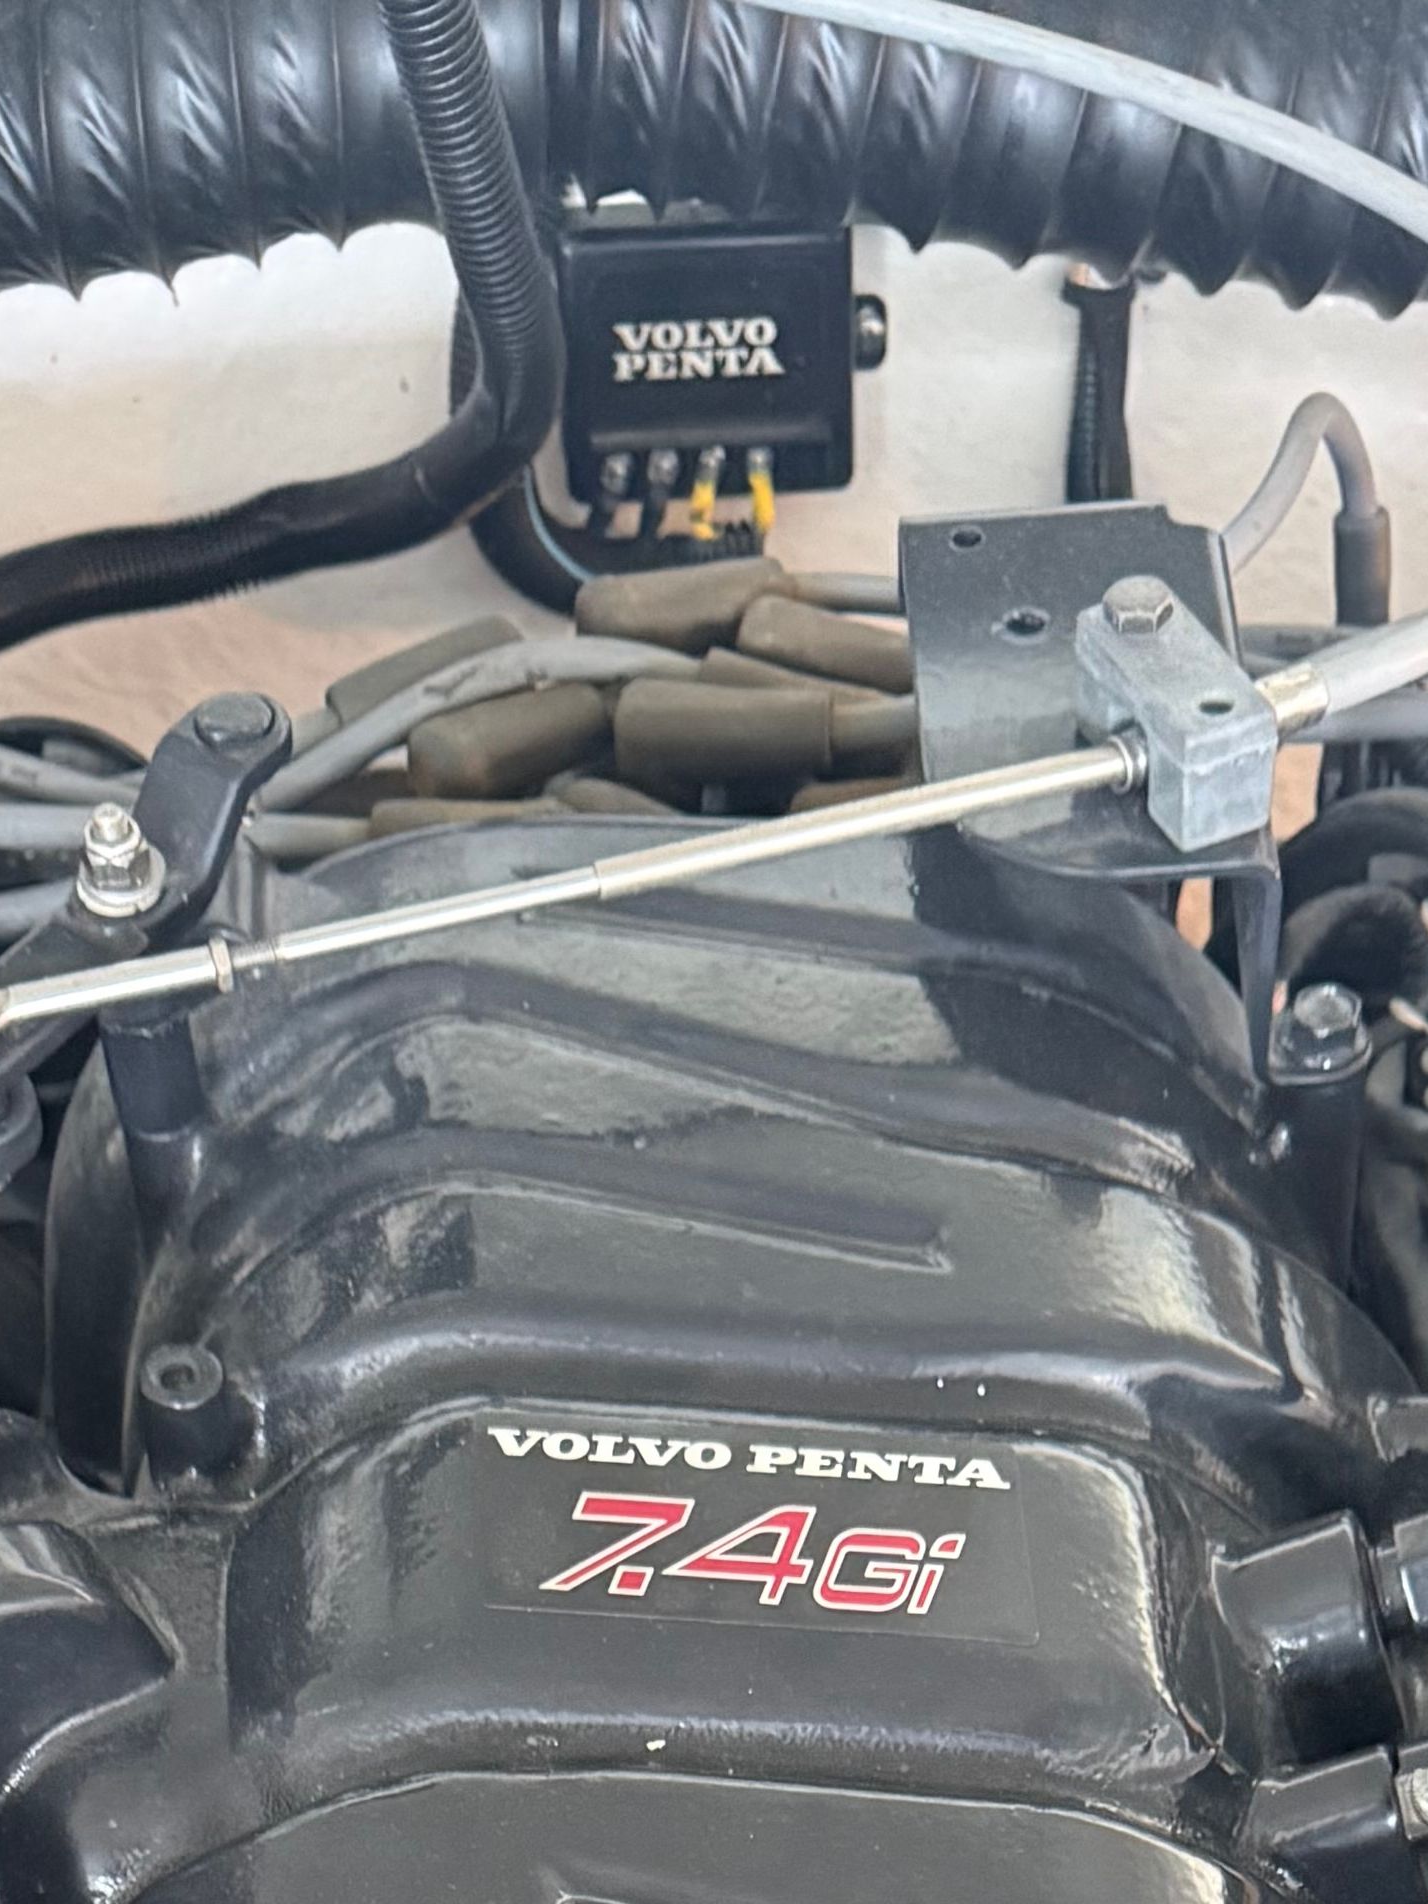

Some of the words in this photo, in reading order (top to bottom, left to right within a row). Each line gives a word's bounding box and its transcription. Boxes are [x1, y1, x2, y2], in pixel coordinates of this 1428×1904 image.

[612, 316, 779, 351] VOLVO
[612, 347, 786, 382] PENTA
[486, 1426, 732, 1470] VOLVO
[746, 1443, 1011, 1491] PENTA
[539, 1489, 967, 1615] 7.4Gi
